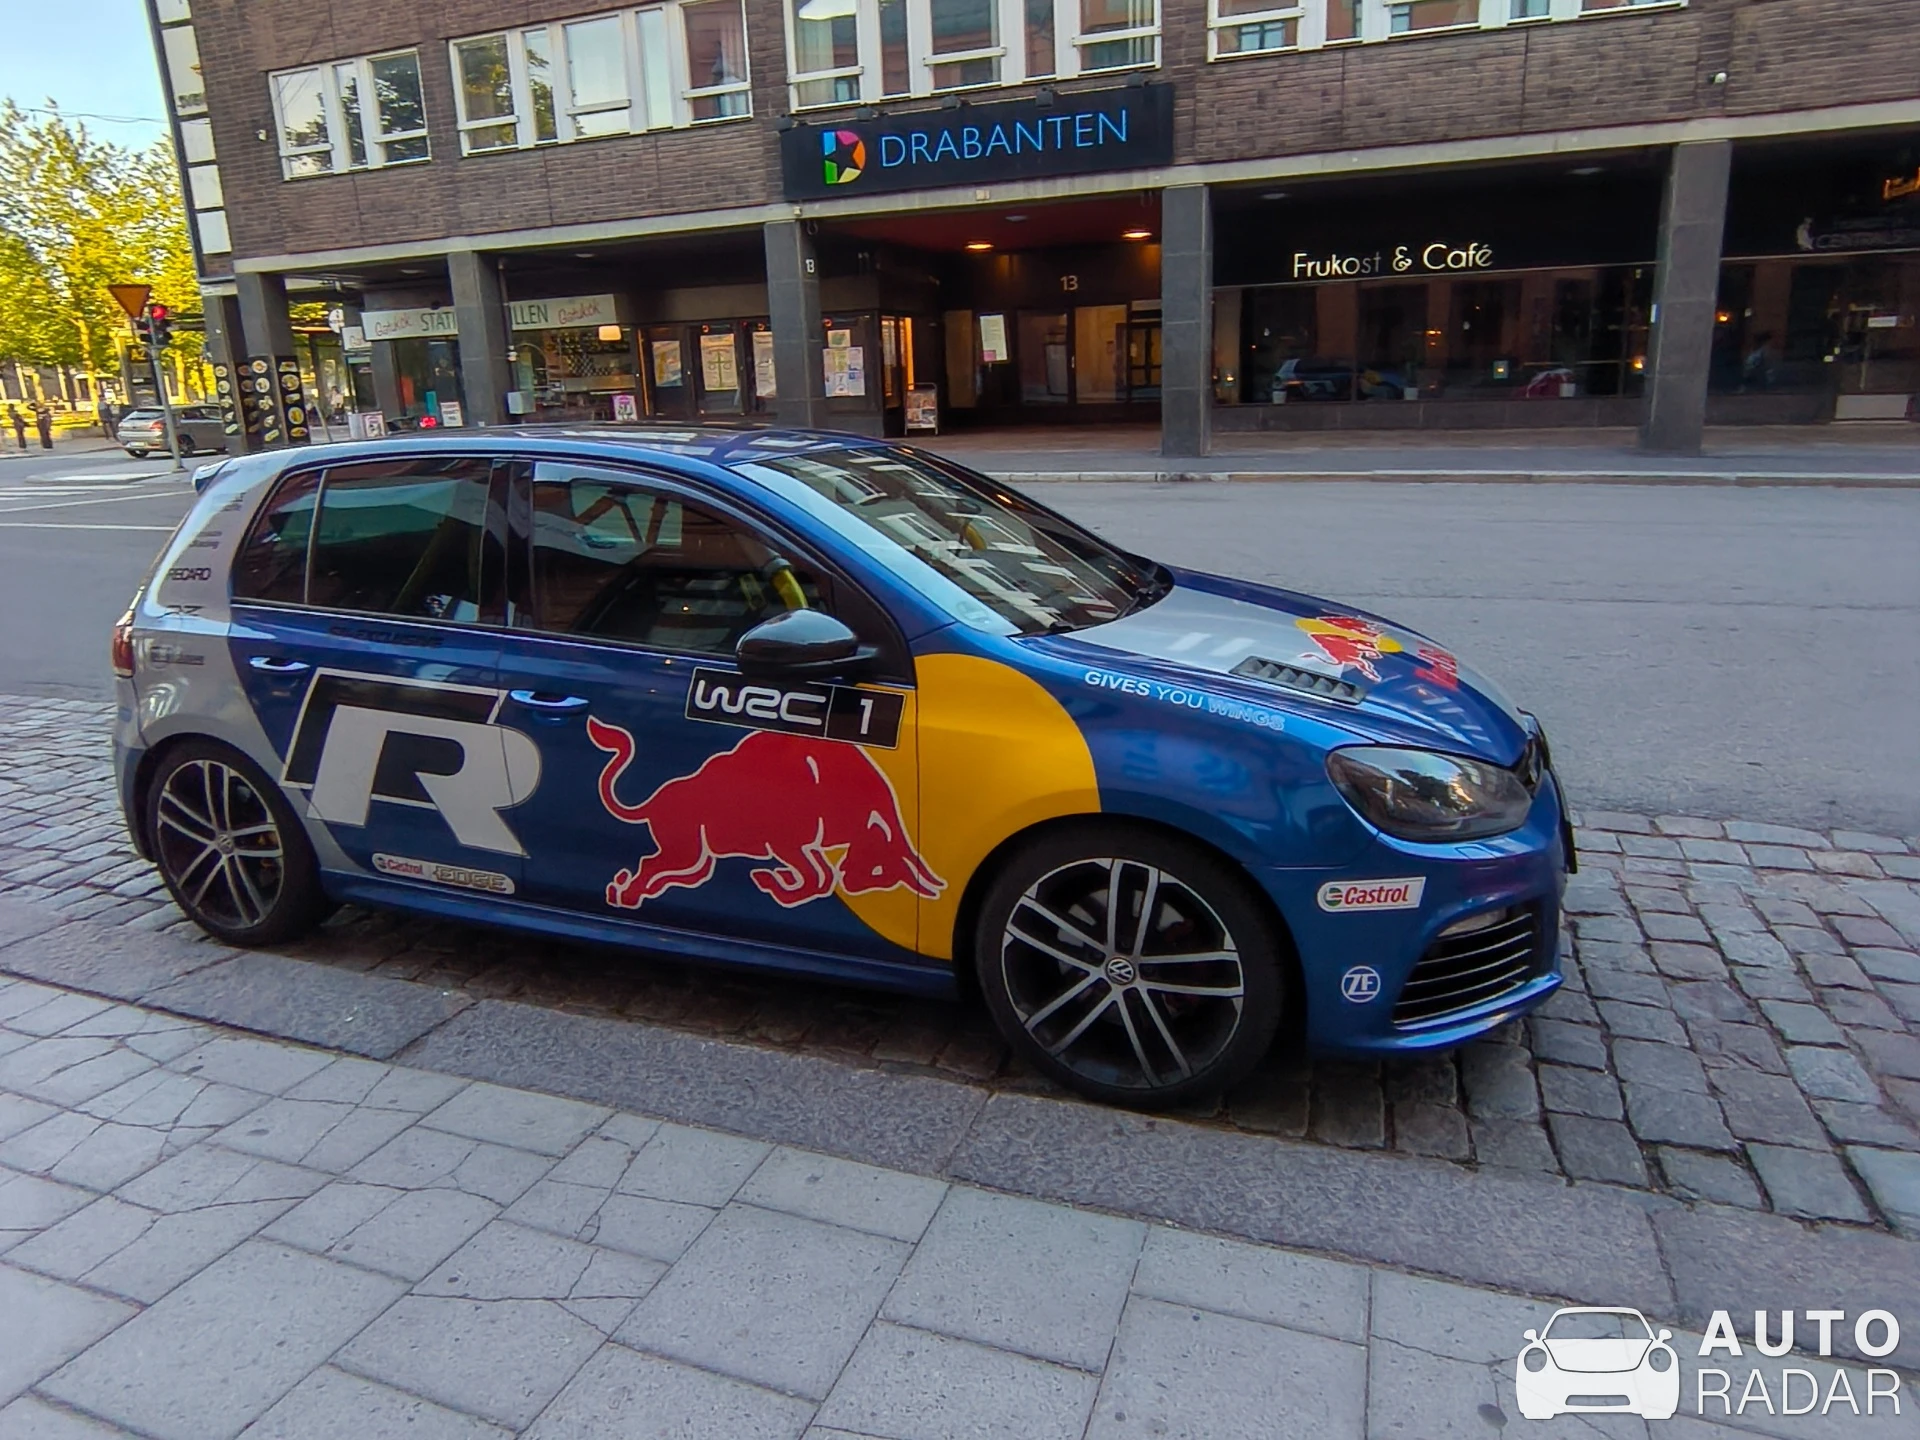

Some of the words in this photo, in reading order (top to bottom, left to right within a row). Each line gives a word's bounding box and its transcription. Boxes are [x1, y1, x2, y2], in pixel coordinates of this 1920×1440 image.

[881, 109, 1128, 168] DRABANTEN
[1293, 251, 1382, 278] Frukost
[1392, 246, 1413, 272] &
[1423, 243, 1494, 270] Café
[1060, 274, 1079, 291] 13
[167, 567, 211, 581] RECARO
[694, 679, 827, 726] WRC
[860, 698, 873, 735] 1
[1084, 670, 1151, 697] GIVES
[1156, 686, 1204, 709] YOU
[1207, 697, 1285, 731] WINGS
[307, 704, 541, 858] R
[385, 859, 423, 875] Castrol
[433, 866, 508, 891] EDGE
[1344, 884, 1410, 905] Castrol
[1343, 972, 1379, 996] ZF
